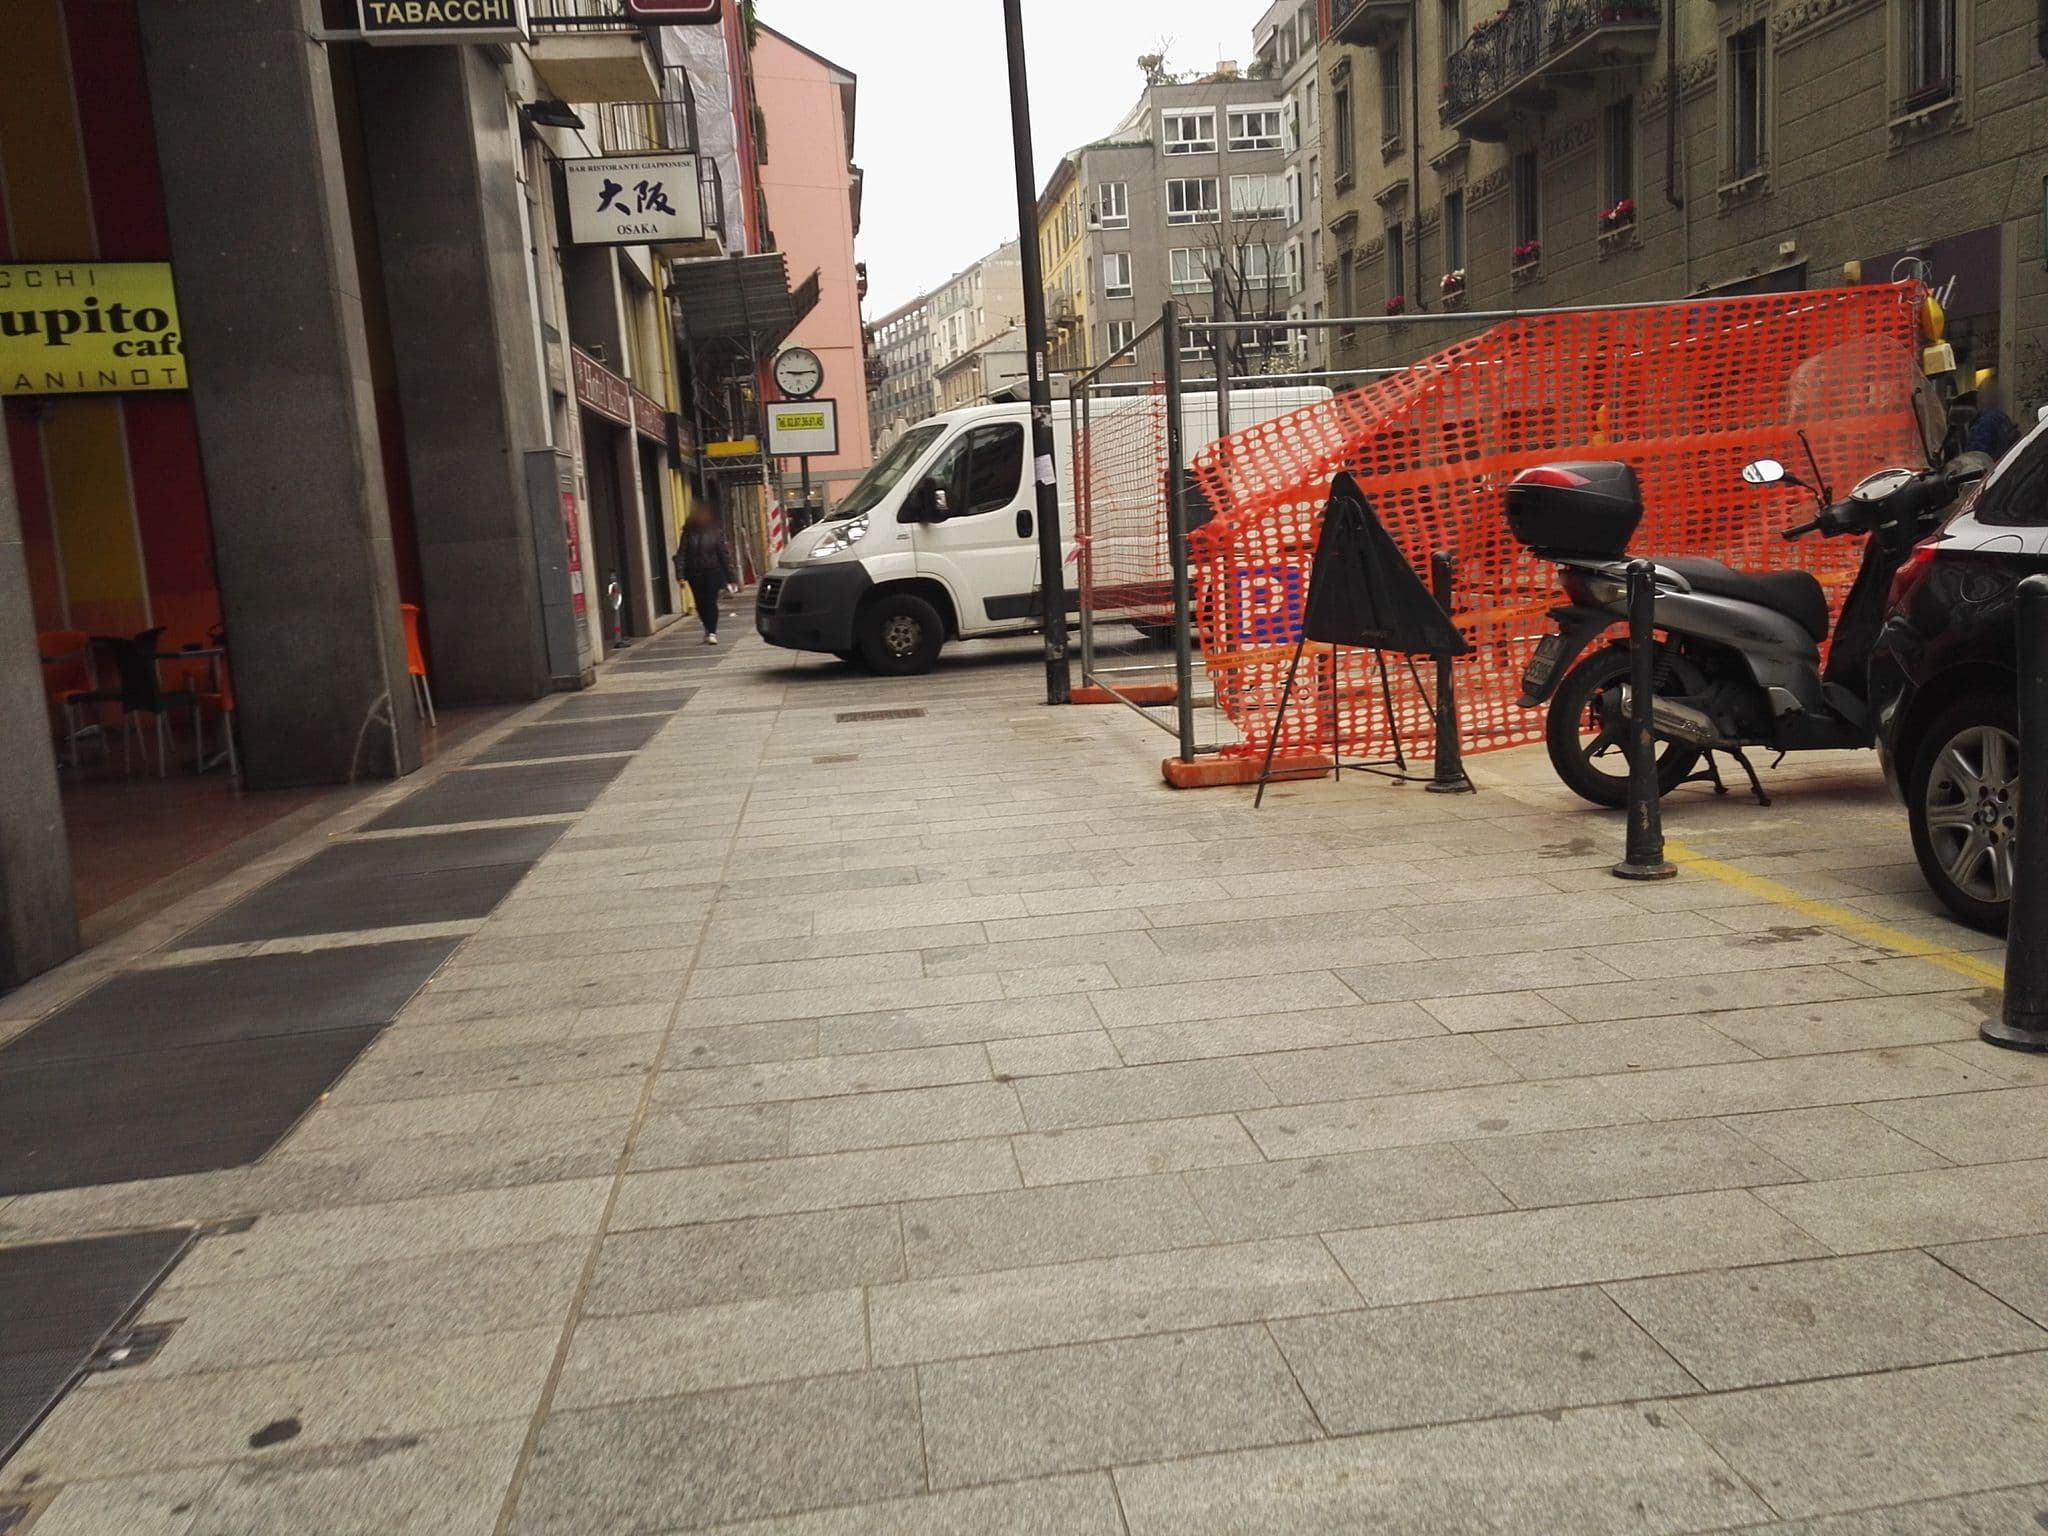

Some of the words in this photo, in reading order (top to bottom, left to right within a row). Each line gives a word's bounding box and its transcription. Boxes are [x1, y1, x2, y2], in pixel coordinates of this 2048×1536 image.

[370, 0, 510, 24] TABACCHI
[588, 163, 640, 172] RISTORANTE
[642, 161, 692, 169] GIAPPONESE
[597, 178, 676, 216] 大阪
[617, 223, 658, 235] OSAKA
